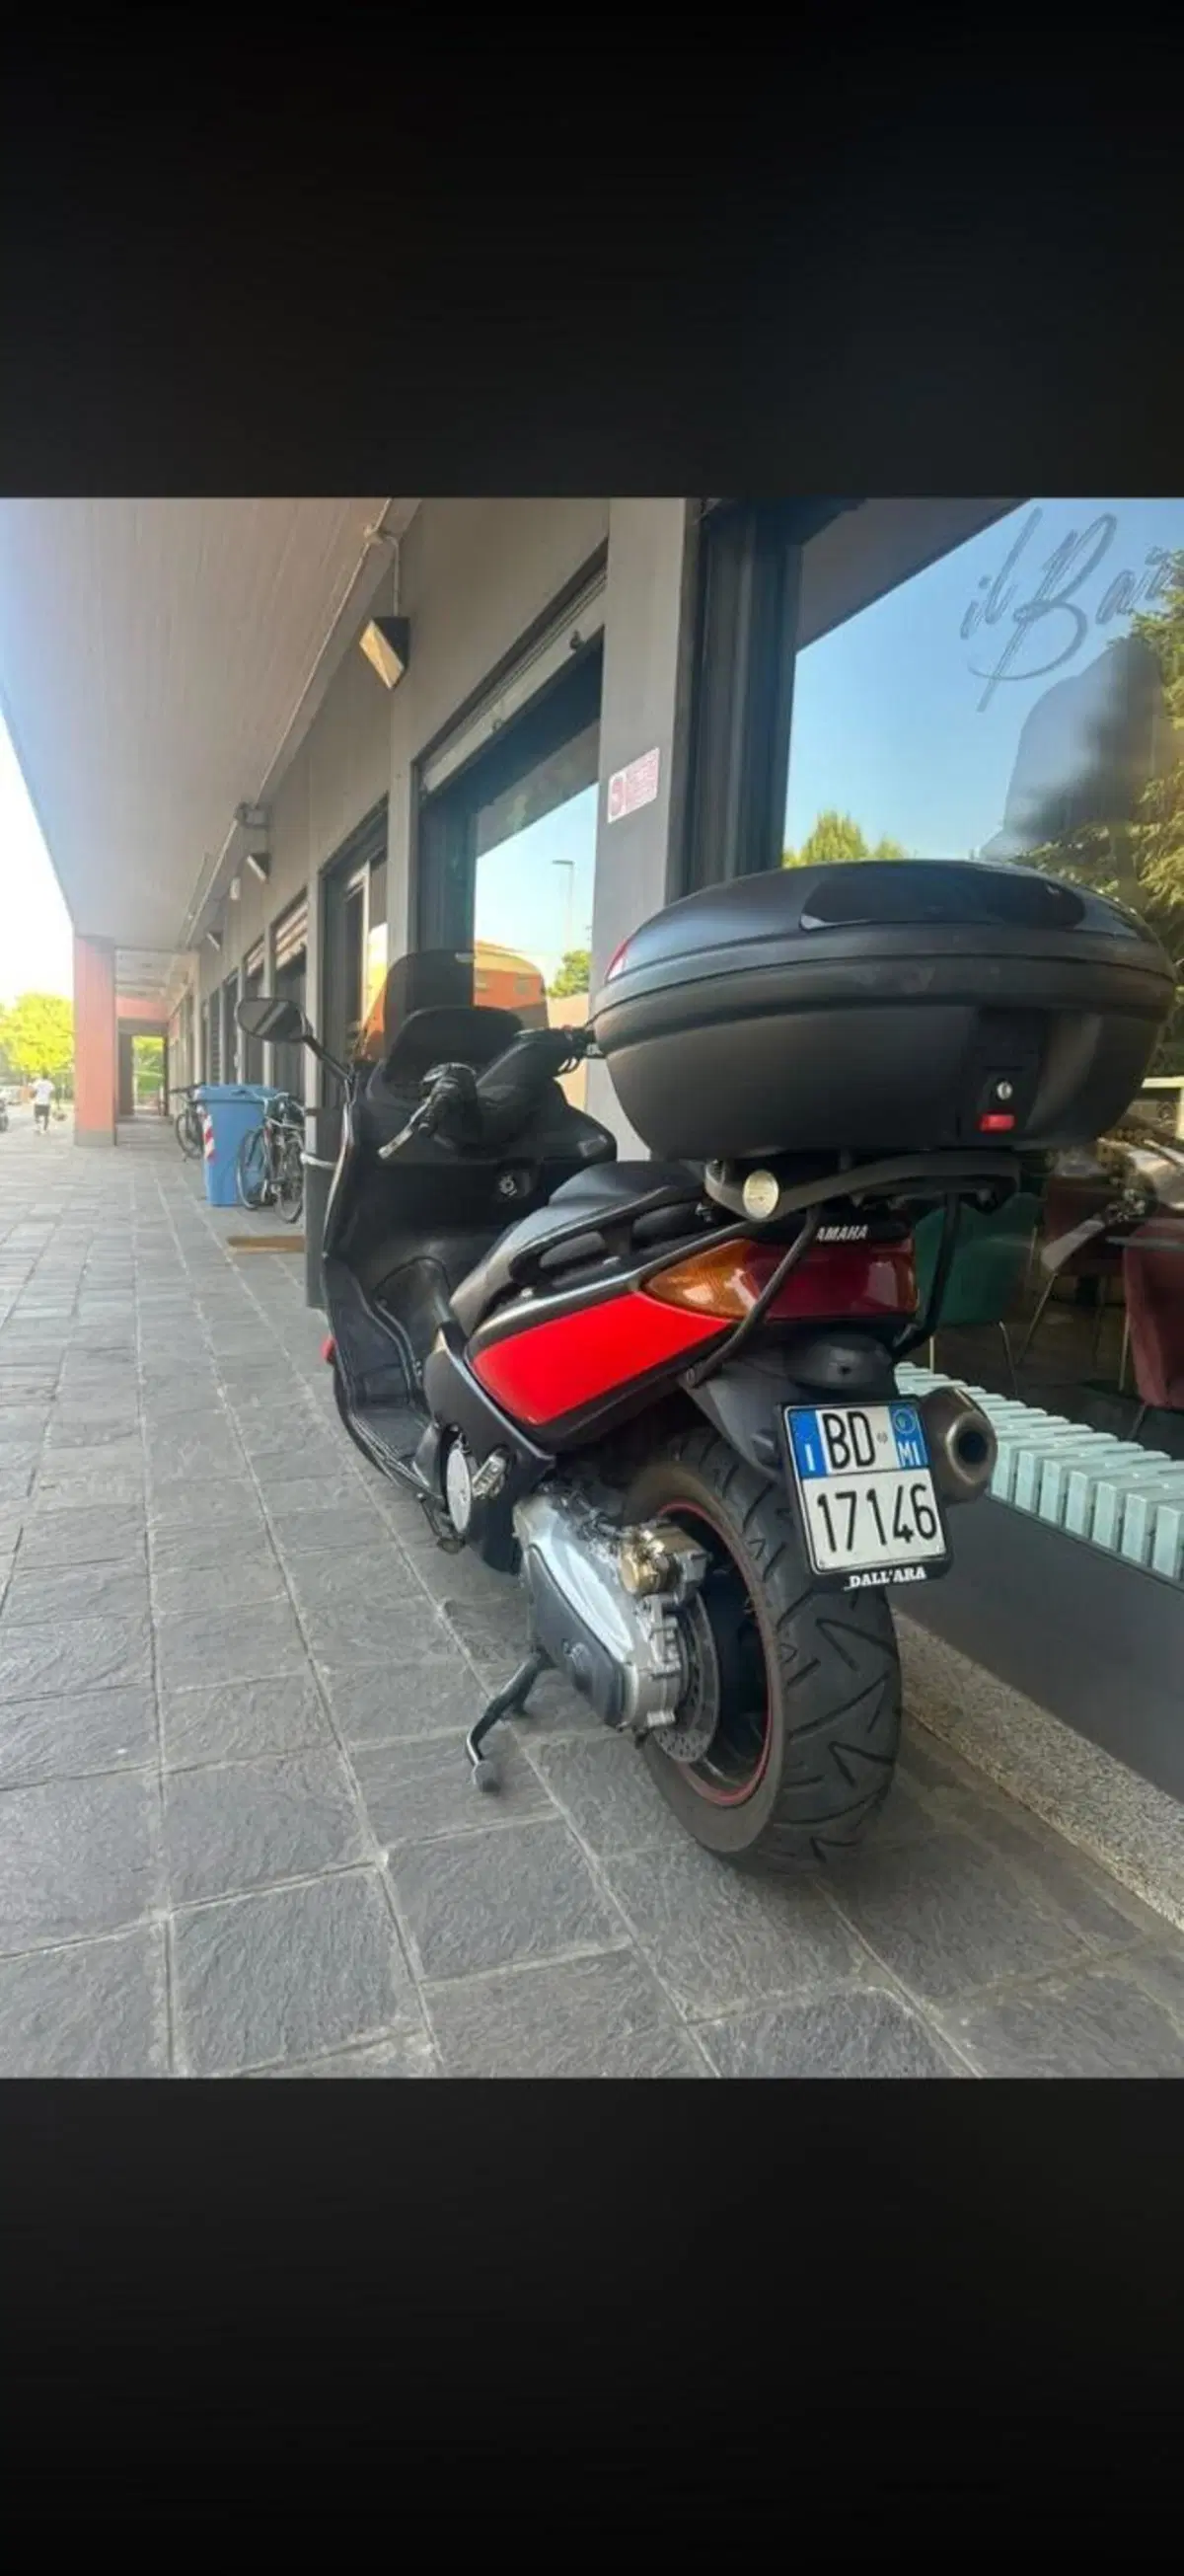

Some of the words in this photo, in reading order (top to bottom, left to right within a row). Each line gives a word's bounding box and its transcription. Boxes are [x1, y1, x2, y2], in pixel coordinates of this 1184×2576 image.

[815, 1224, 868, 1243] AMAHA
[804, 1443, 816, 1472] I
[821, 1410, 876, 1470] BD
[897, 1439, 922, 1467] MI
[816, 1482, 937, 1553] 17146
[849, 1565, 926, 1589] DALL'ARA
